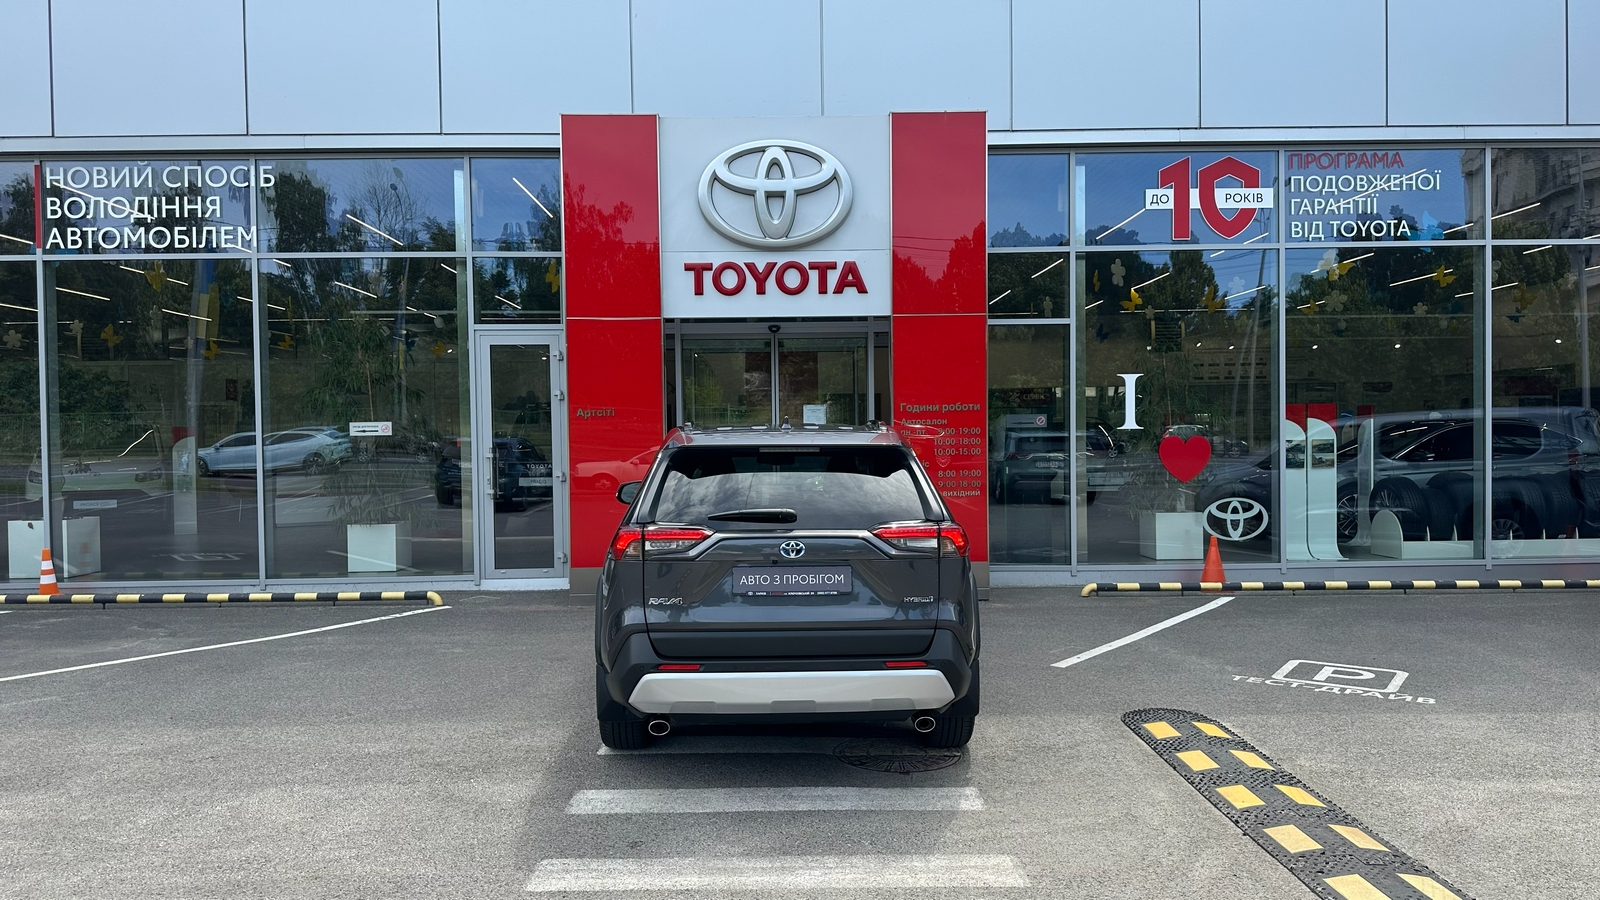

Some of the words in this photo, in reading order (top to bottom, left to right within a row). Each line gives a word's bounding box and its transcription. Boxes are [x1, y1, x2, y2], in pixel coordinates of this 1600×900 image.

[1289, 152, 1404, 169] ПРОГРАМА
[46, 160, 152, 188] НОВИЙ
[162, 165, 275, 188] СПОСІБ
[1290, 170, 1441, 194] ПОДОВЖЕНОЇ
[1150, 194, 1170, 206] ДО
[1225, 193, 1264, 204] РОКІВ
[1290, 194, 1378, 215] ГАРАНТІЇ
[46, 196, 221, 223] ВОЛОДІННЯ
[45, 226, 258, 250] АВТОМОБІЛЕМ
[1291, 222, 1325, 241] ВІД
[1329, 220, 1411, 237] TOYOTA
[684, 260, 868, 296] TOYOTA
[900, 403, 939, 413] Години
[942, 402, 980, 413] роботи
[1117, 373, 1144, 430] I
[576, 407, 615, 418] Артсіті
[942, 489, 980, 498] вихідний
[739, 574, 771, 586] АВТО
[783, 573, 845, 585] ПРОБІГОМ
[648, 597, 683, 606] RAV4
[1231, 675, 1436, 704] ТЕСТ-ДРАЙВ
